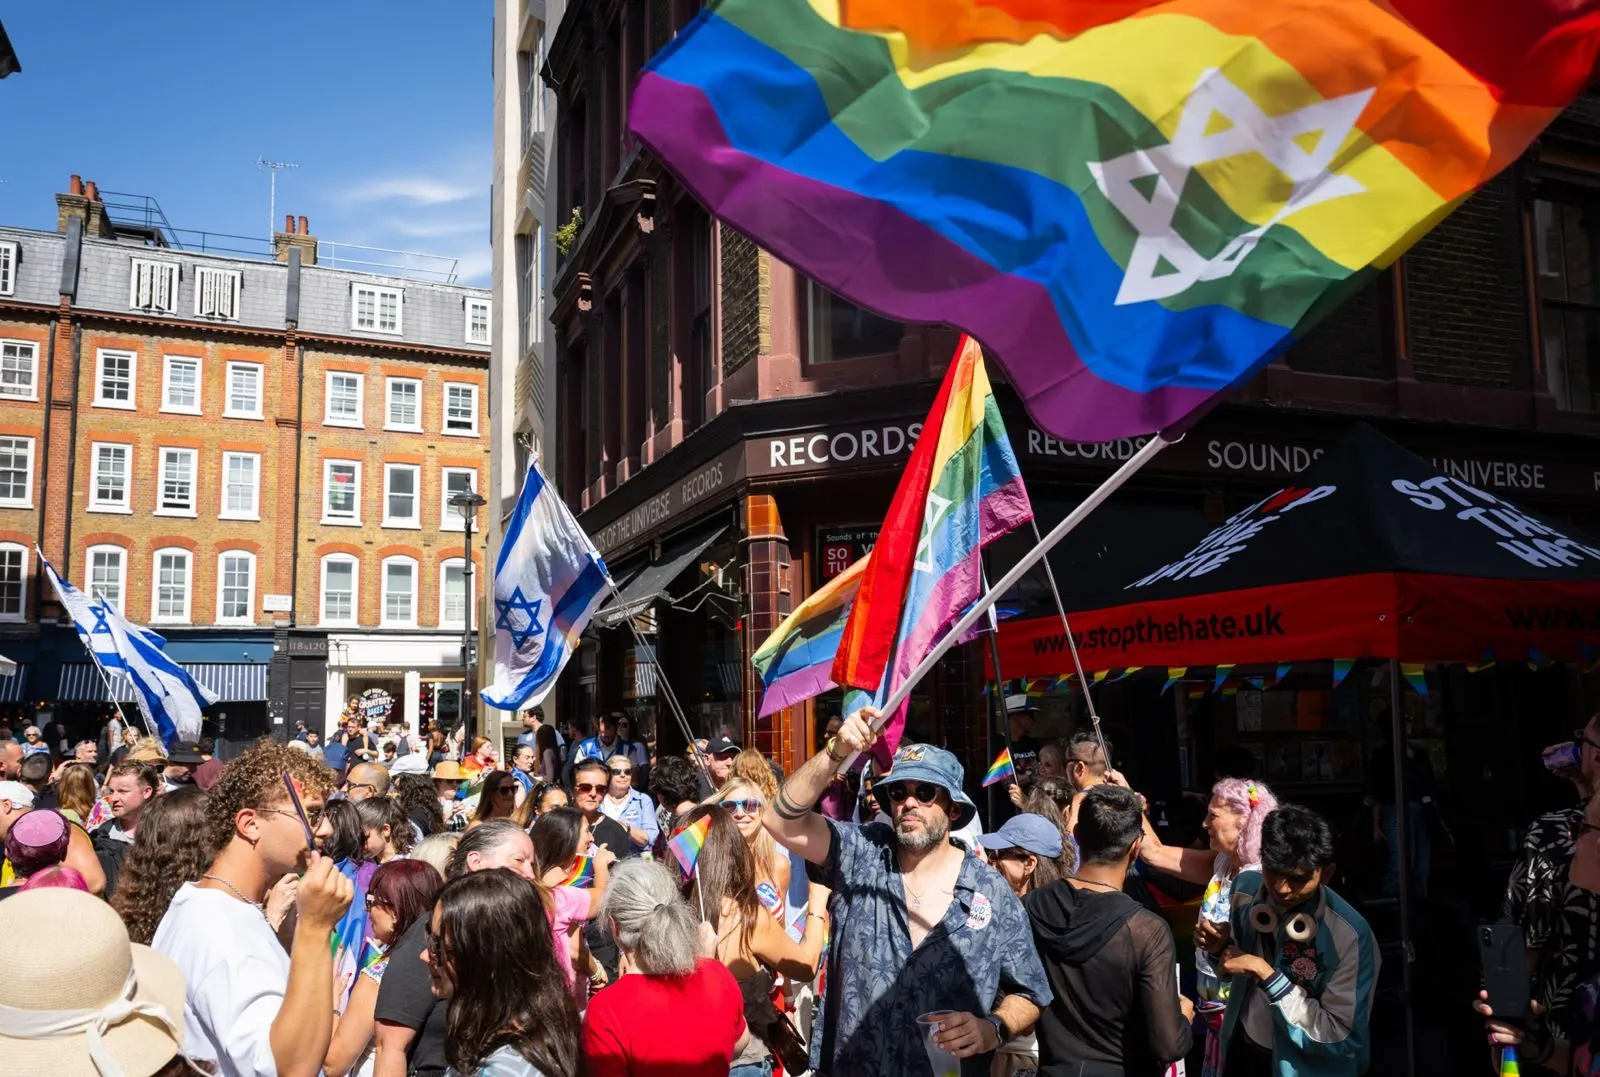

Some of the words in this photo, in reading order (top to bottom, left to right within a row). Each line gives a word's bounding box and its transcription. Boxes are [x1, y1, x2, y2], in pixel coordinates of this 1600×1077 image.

[770, 422, 924, 468] RECORDS
[1208, 440, 1324, 473] SOUND
[606, 526, 618, 548] OF
[617, 516, 630, 541] THE
[631, 492, 671, 535] UNIVERSE
[682, 462, 723, 505] RECORDS
[826, 533, 852, 541] Sounds
[856, 532, 865, 540] of
[869, 531, 880, 539] th
[828, 548, 848, 560] SO
[1032, 605, 1285, 655] www.stopthehate.uk
